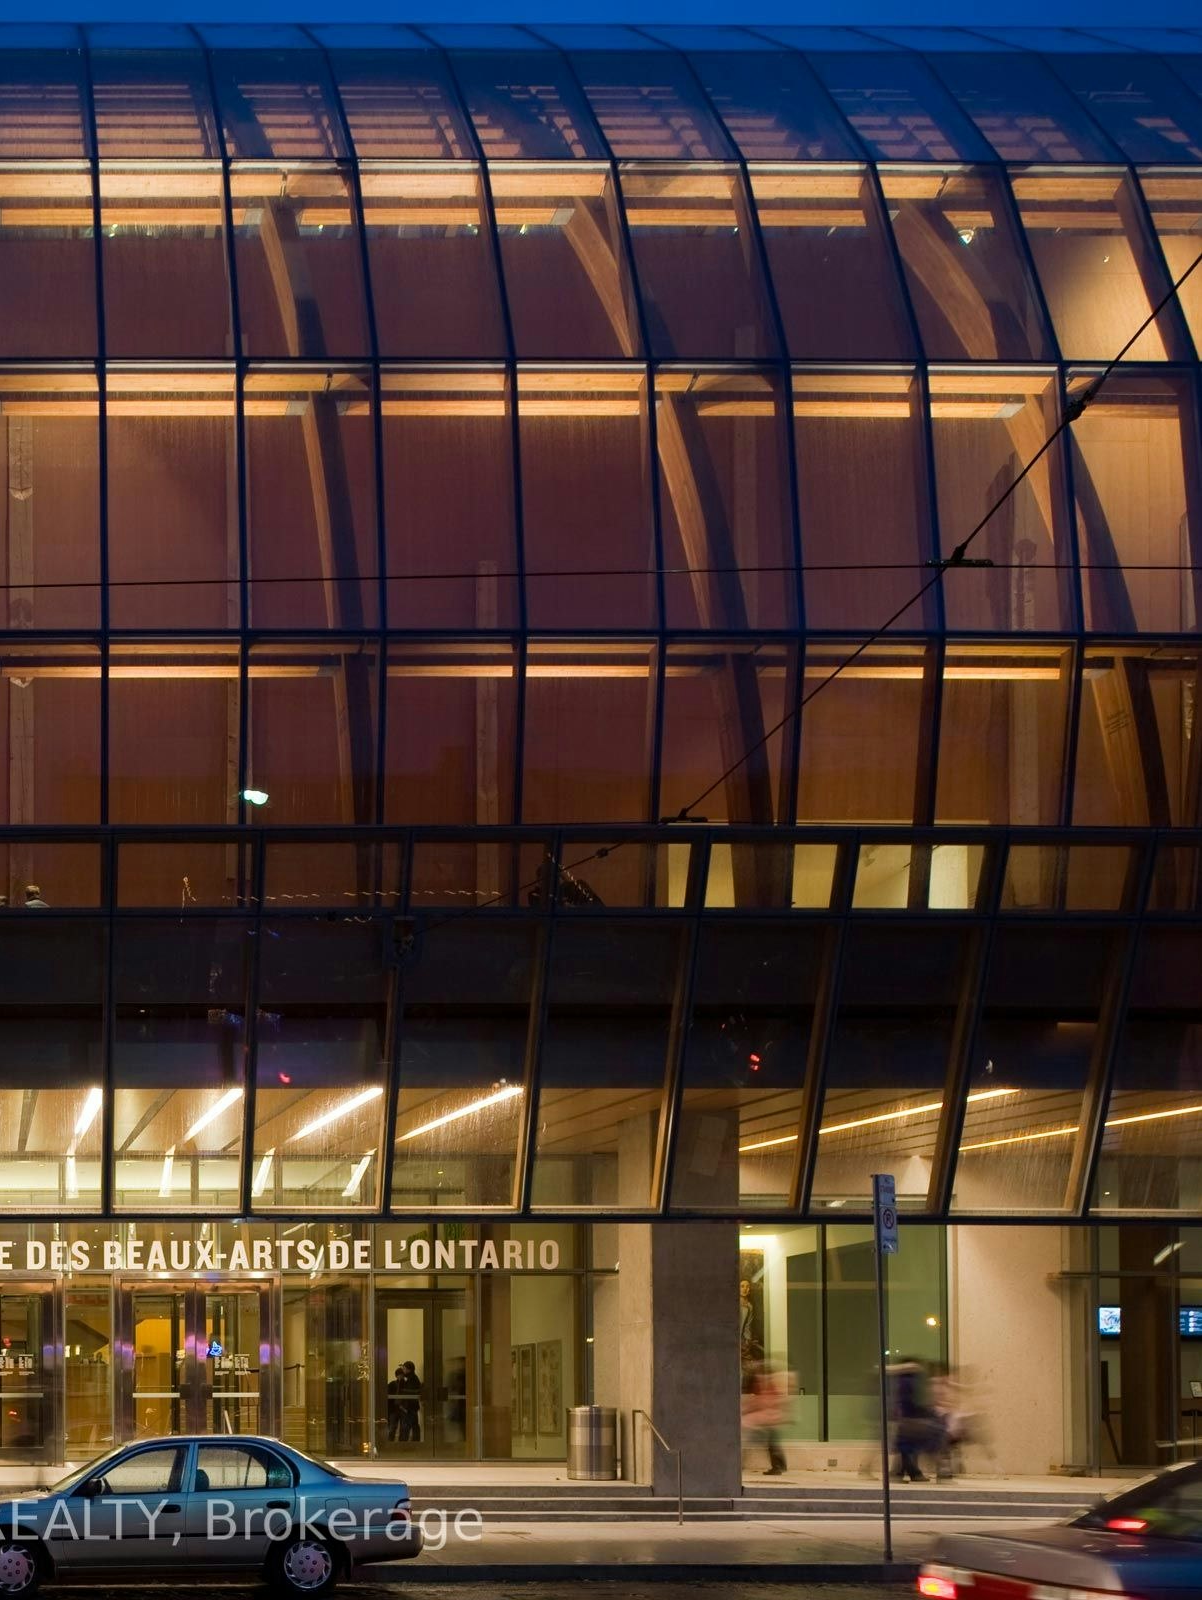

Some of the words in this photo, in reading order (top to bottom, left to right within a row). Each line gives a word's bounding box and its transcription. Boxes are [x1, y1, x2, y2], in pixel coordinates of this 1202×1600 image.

[26, 1241, 90, 1271] DES
[103, 1240, 315, 1270] BEAUX-ARTS
[328, 1240, 372, 1270] DE
[384, 1239, 560, 1270] L'ONTARIO
